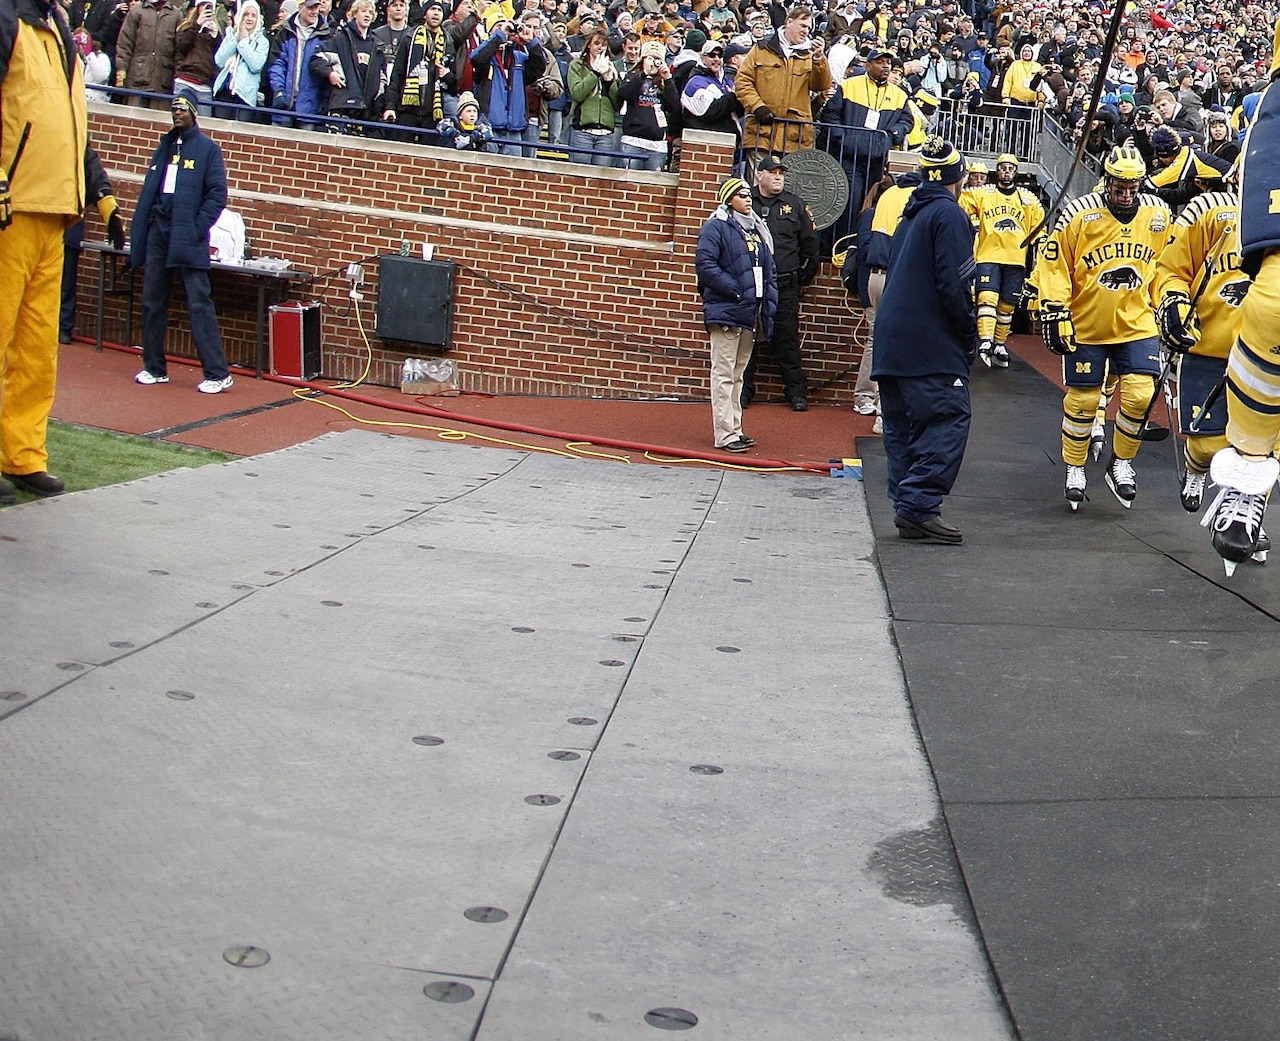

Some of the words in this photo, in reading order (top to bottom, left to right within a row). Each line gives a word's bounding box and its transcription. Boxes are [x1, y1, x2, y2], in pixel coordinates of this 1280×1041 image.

[183, 159, 195, 170] M
[928, 169, 942, 182] M
[1041, 312, 1069, 322] CCM
[1076, 362, 1092, 374] M
